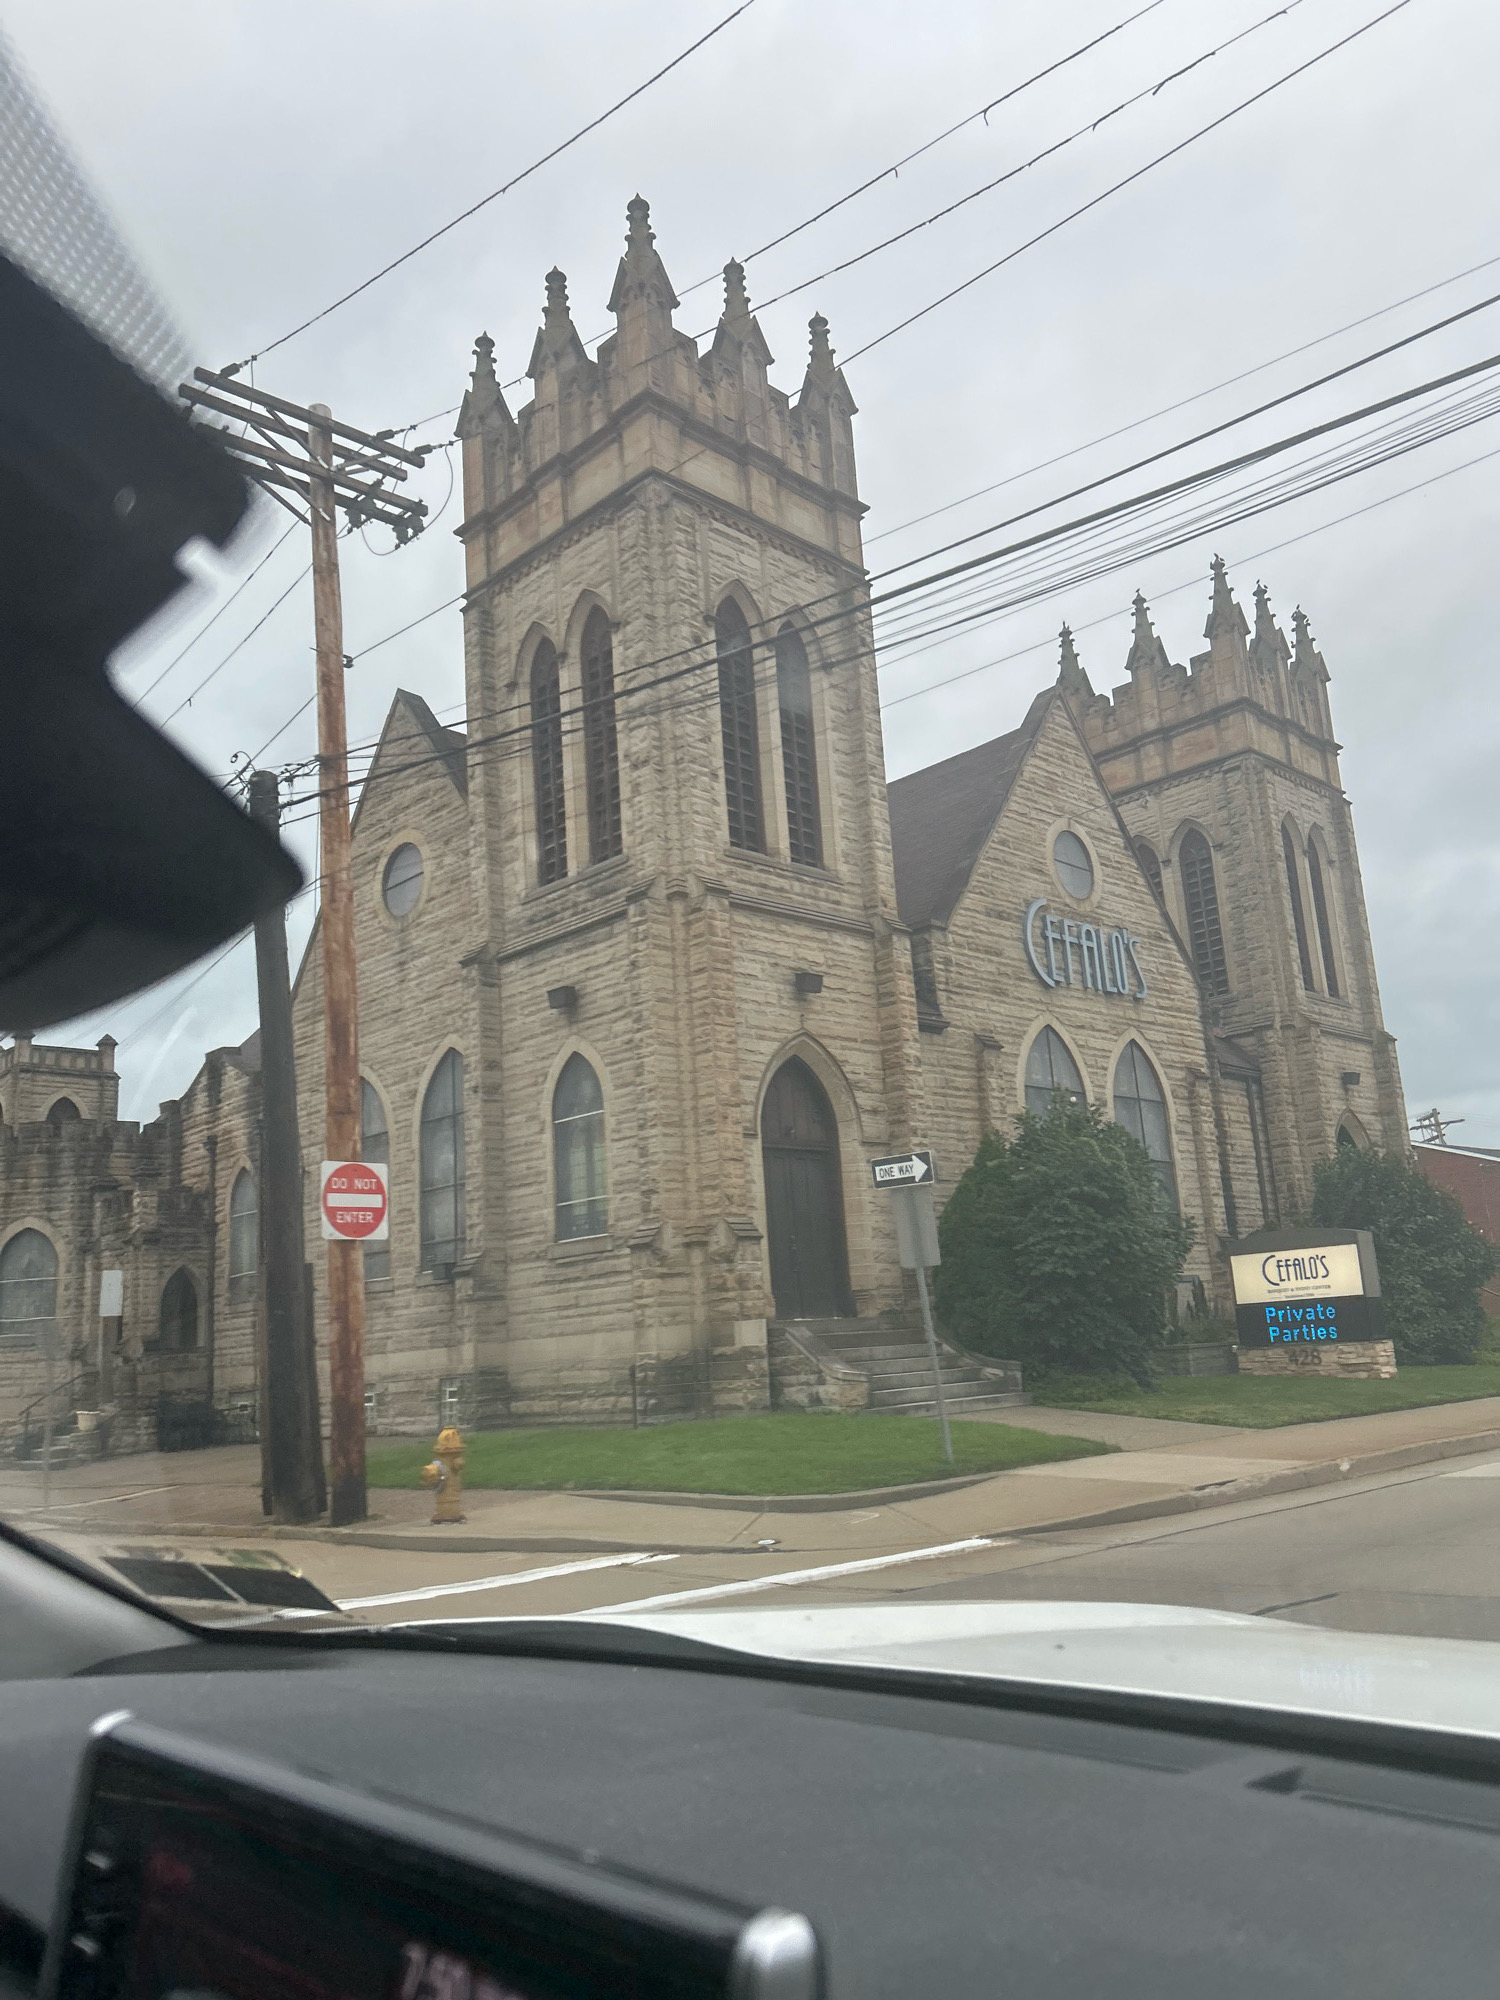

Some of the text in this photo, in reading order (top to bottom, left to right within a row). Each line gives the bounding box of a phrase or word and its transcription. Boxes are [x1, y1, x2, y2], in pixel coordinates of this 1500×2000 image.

[1023, 898, 1148, 999] CEFALO'S
[879, 1164, 914, 1179] ONE WAY
[331, 1177, 377, 1190] DO NOT
[336, 1211, 374, 1223] ENTER
[1262, 1254, 1330, 1286] CEFALO'S
[1265, 1303, 1336, 1323] Private
[1269, 1324, 1338, 1342] Parties
[1289, 1349, 1323, 1366] 428
